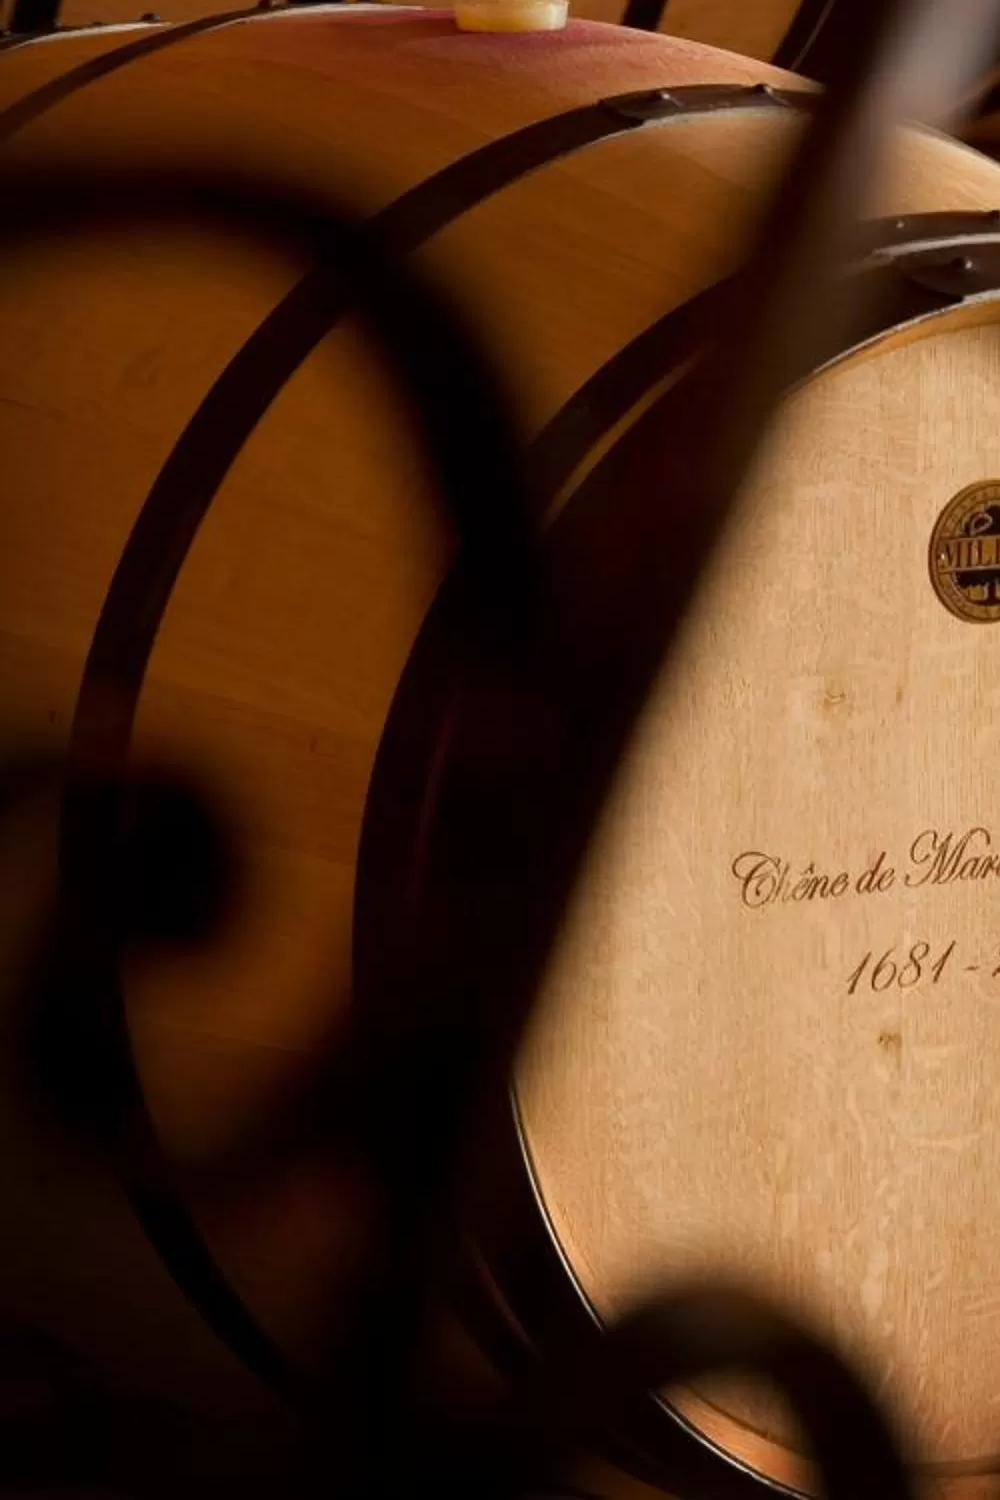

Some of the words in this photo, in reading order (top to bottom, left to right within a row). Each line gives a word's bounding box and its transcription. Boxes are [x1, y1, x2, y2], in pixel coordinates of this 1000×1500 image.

[731, 850, 850, 909] Chêne
[855, 851, 896, 895] de
[846, 940, 957, 995] 1681
